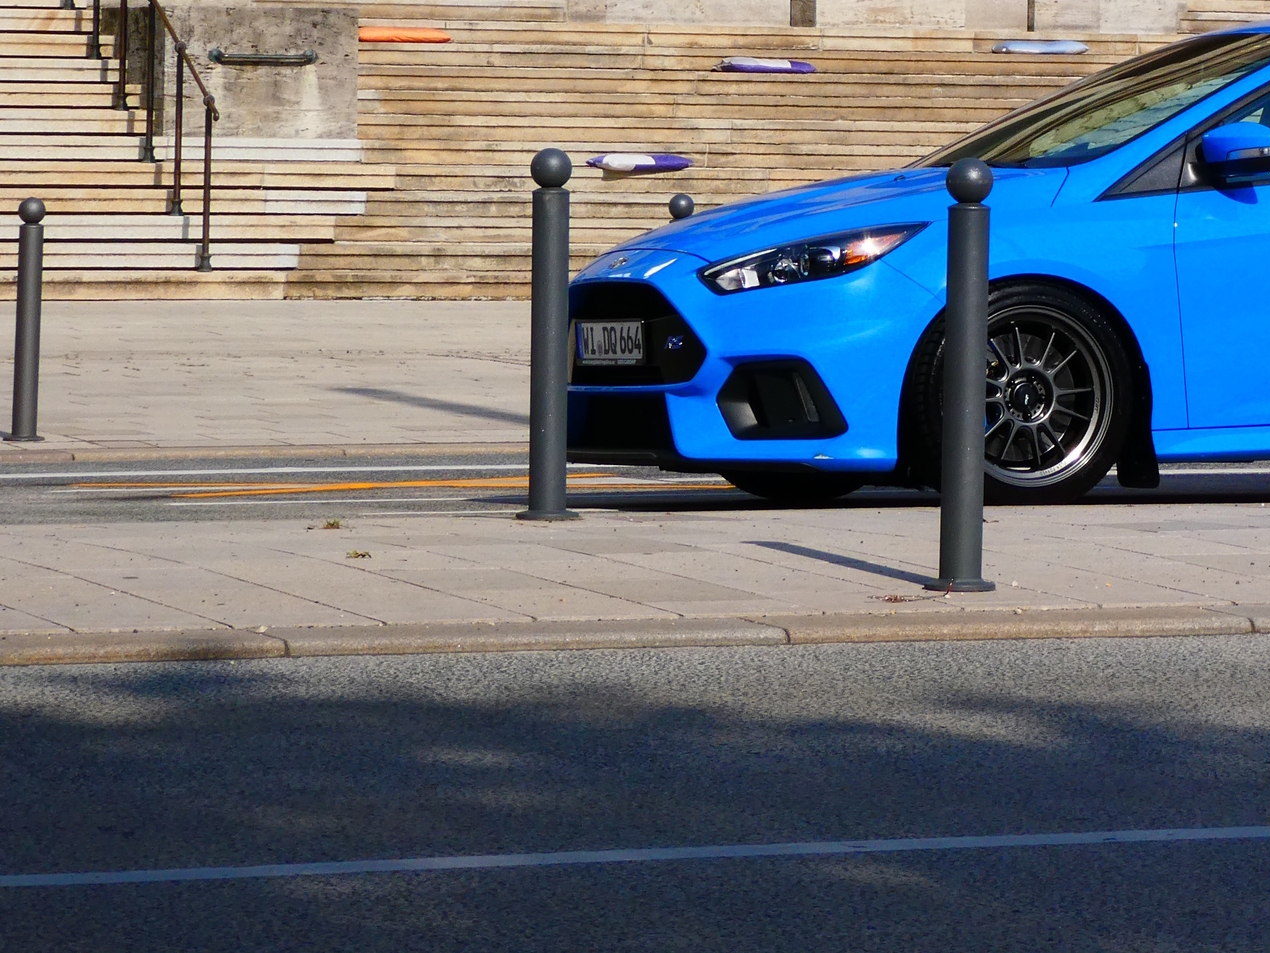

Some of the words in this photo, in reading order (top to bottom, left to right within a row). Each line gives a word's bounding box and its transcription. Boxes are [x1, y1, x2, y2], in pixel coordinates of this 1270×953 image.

[582, 326, 597, 355] WI
[602, 326, 618, 355] DQ
[619, 325, 642, 355] 664
